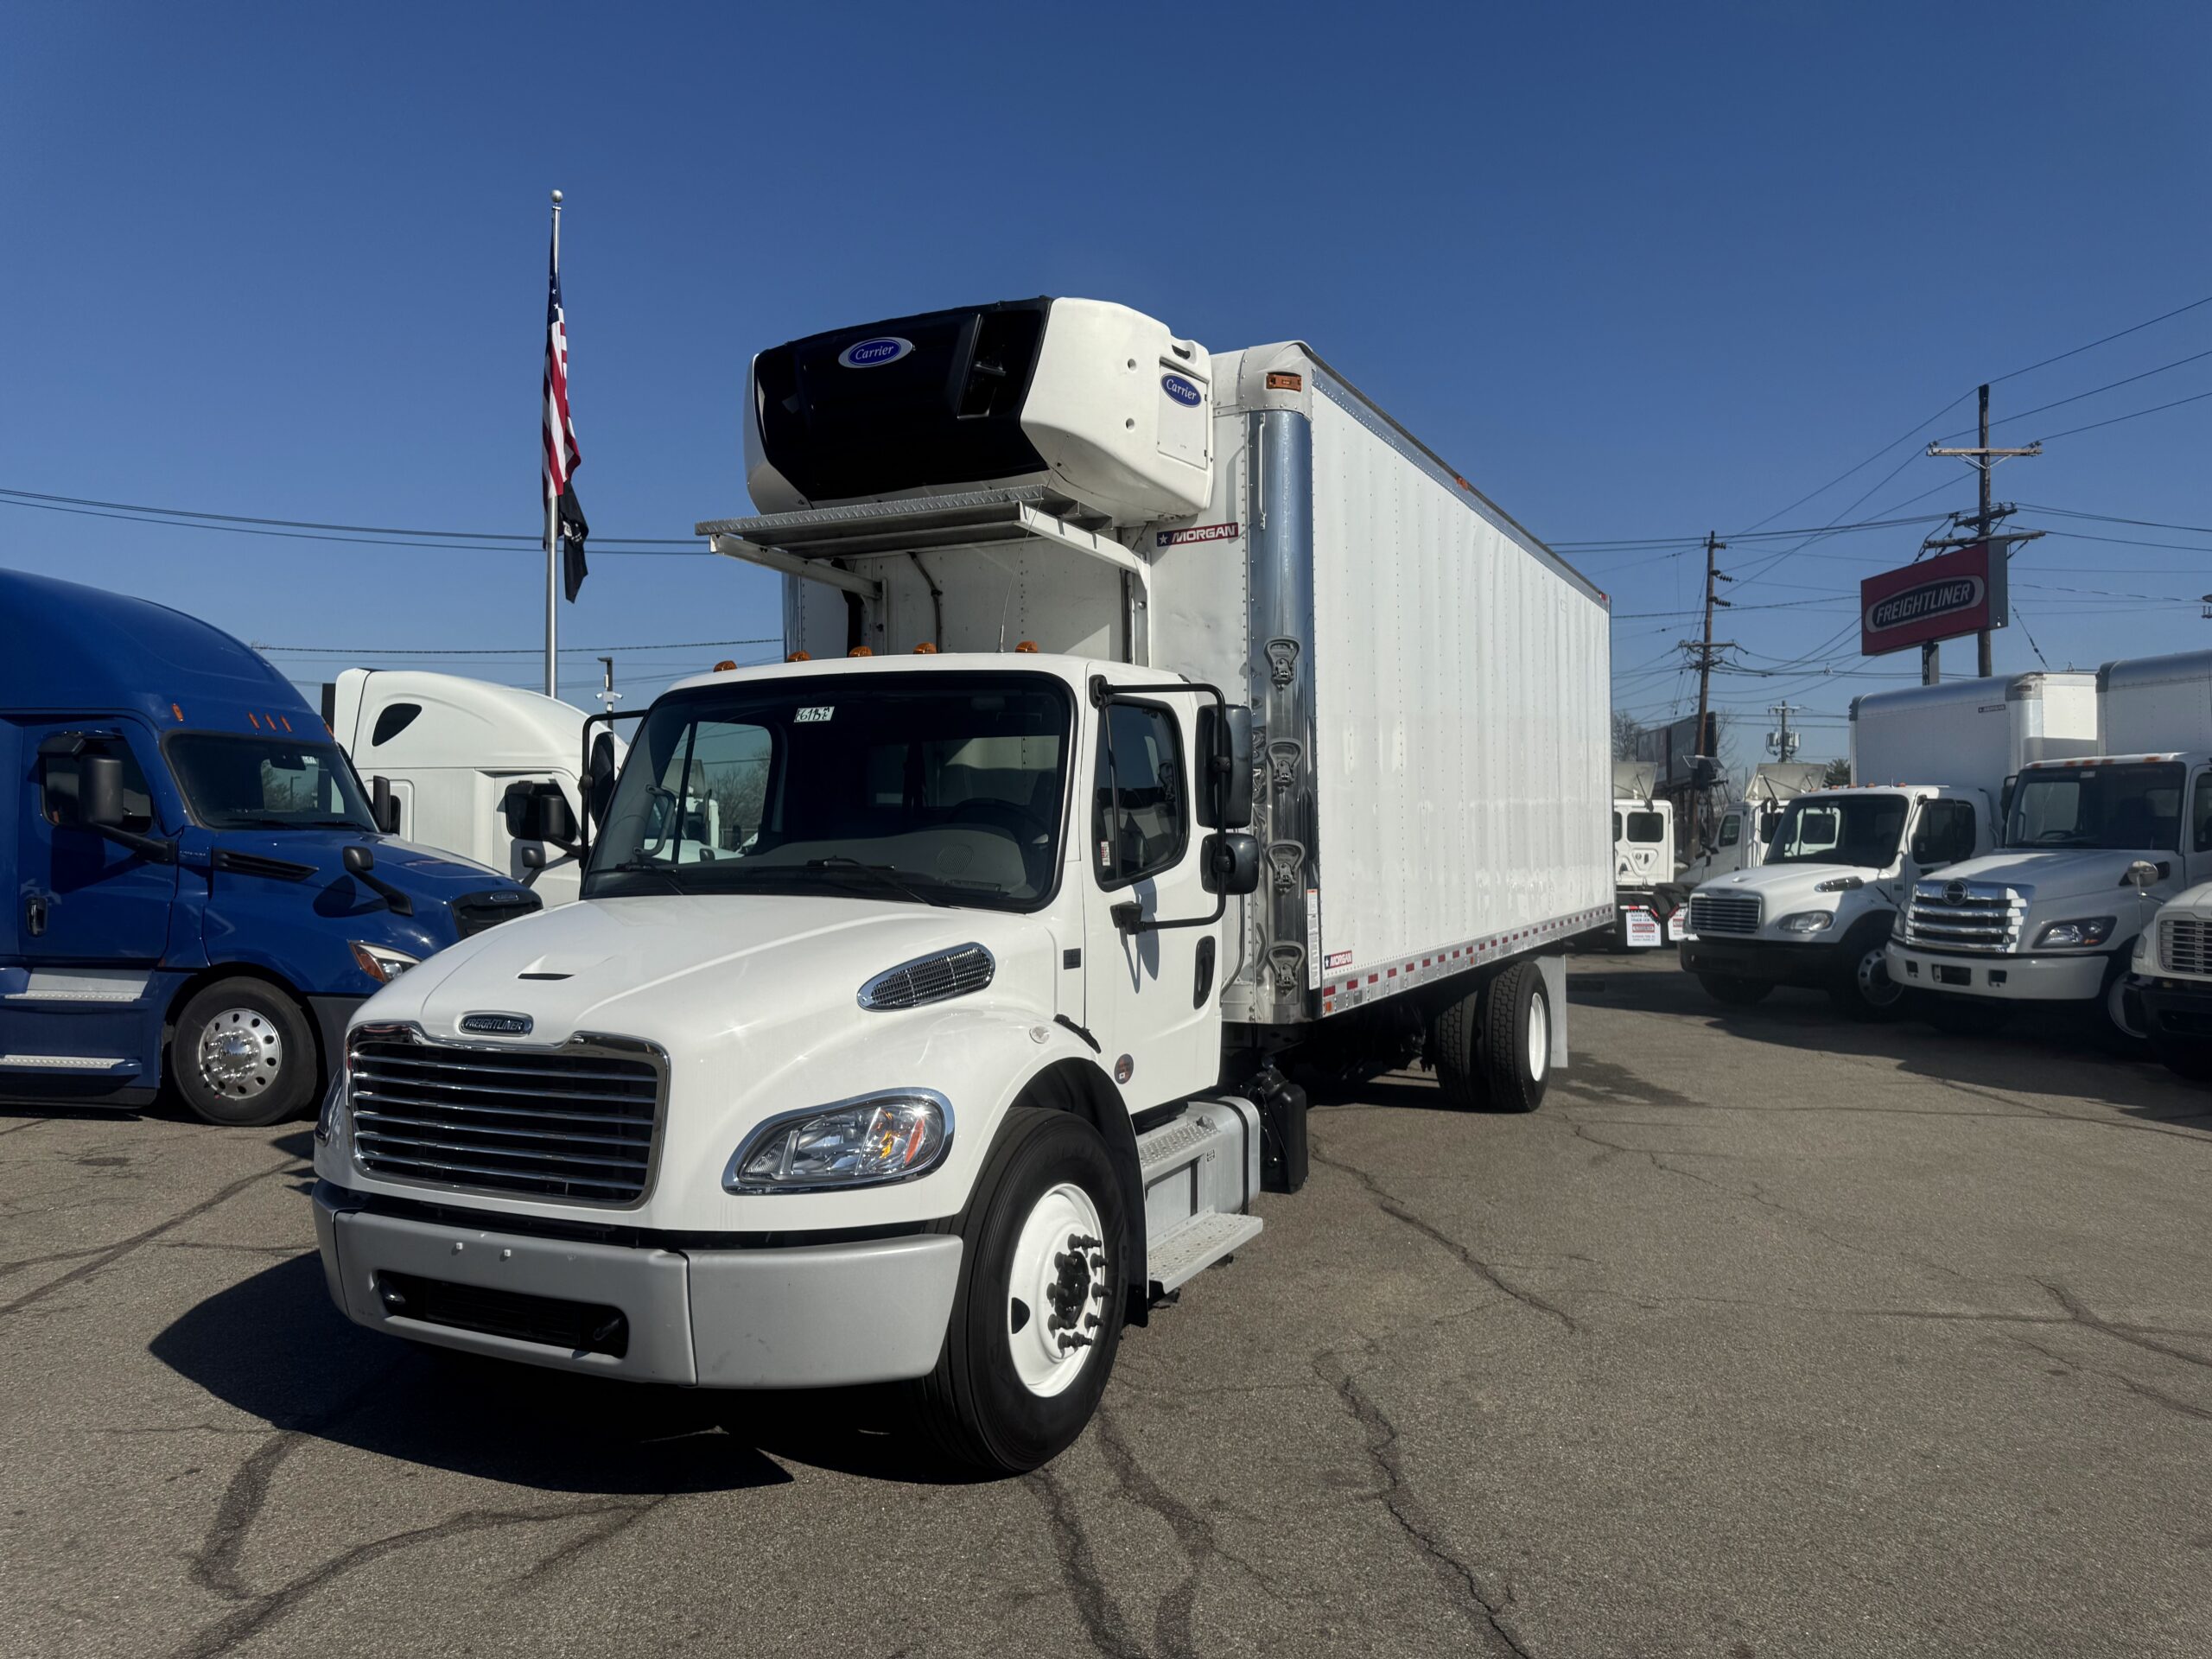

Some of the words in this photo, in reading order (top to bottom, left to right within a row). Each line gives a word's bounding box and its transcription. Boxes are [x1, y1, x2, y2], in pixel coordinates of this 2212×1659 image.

[855, 346, 894, 360] Carrier
[1166, 378, 1197, 400] Carrier
[1171, 524, 1236, 543] MORGAN
[1877, 582, 1971, 625] FREIGHTLINER
[1330, 952, 1352, 967] MORGAN
[465, 1019, 523, 1031] FREIGHTLINER
